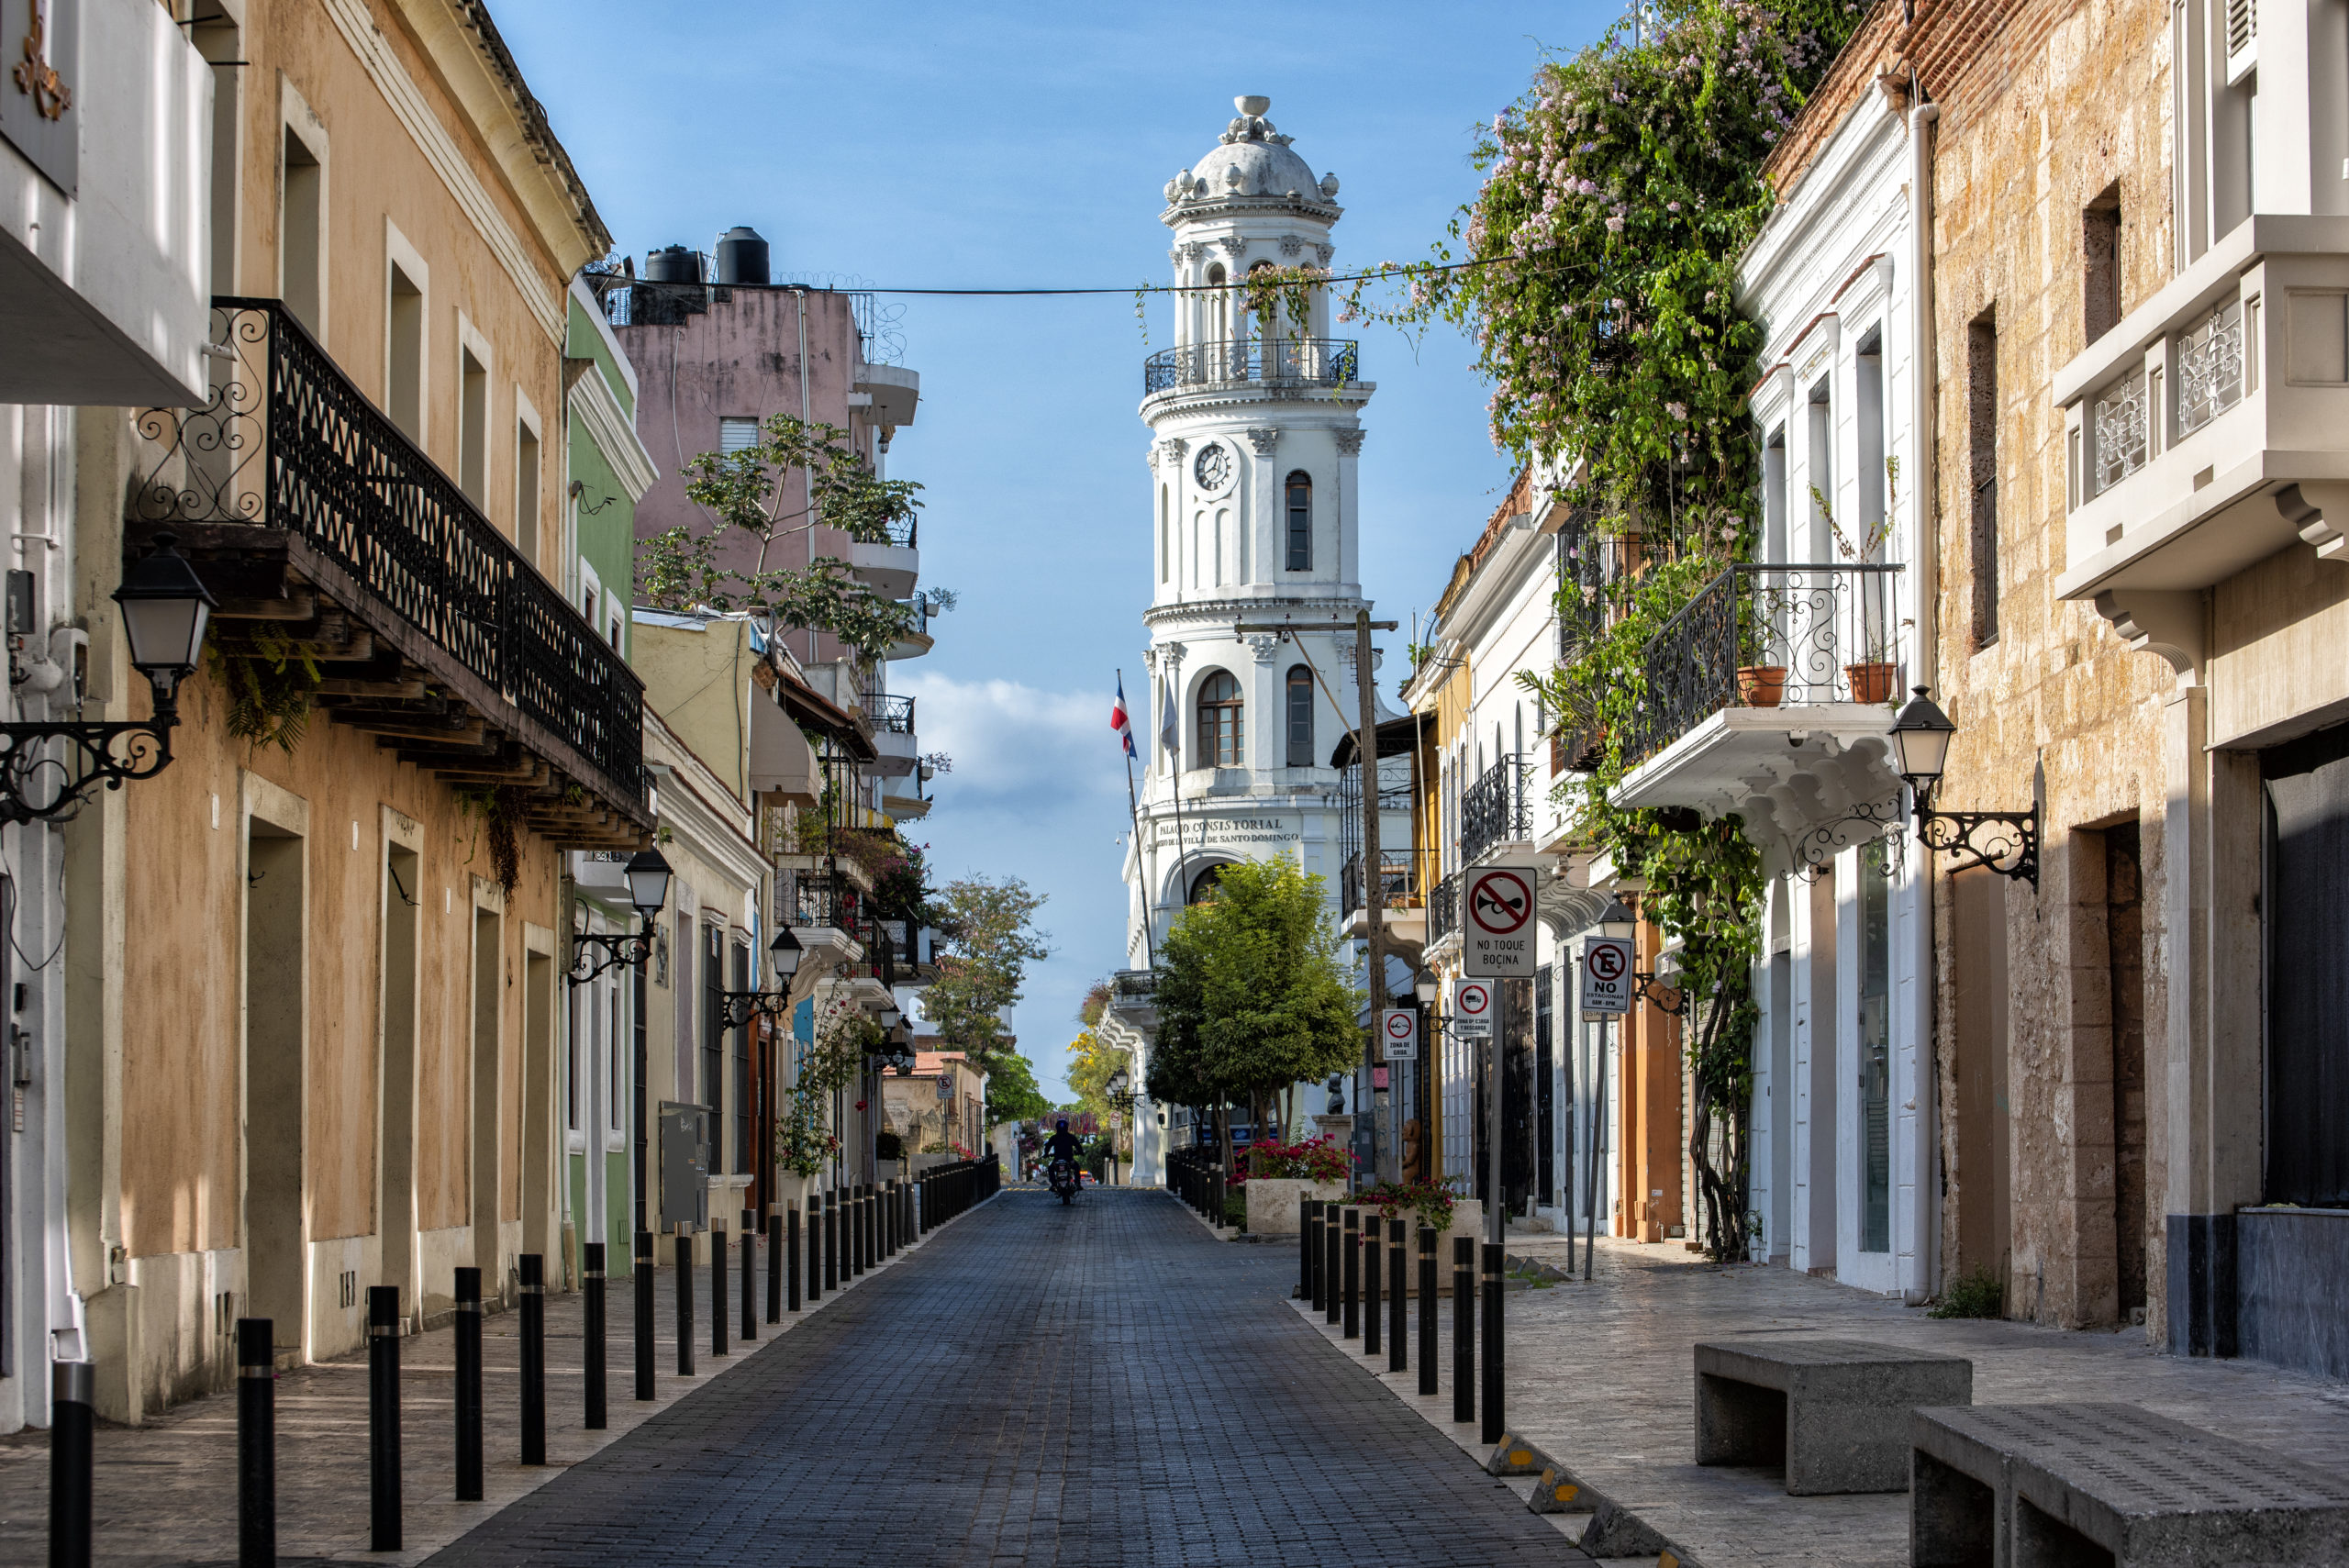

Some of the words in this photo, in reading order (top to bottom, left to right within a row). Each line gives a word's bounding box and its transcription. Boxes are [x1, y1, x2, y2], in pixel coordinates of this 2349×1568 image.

[1193, 818, 1283, 832] CONSISTORIAL
[1219, 835, 1249, 843] SANTO
[1251, 833, 1298, 842] DOMINGO
[1477, 940, 1490, 951] NO
[1495, 940, 1525, 951] TOQUE
[1483, 954, 1520, 965] BOCINA
[1594, 982, 1617, 994] NO
[1586, 992, 1624, 1000] ESTACIONAR
